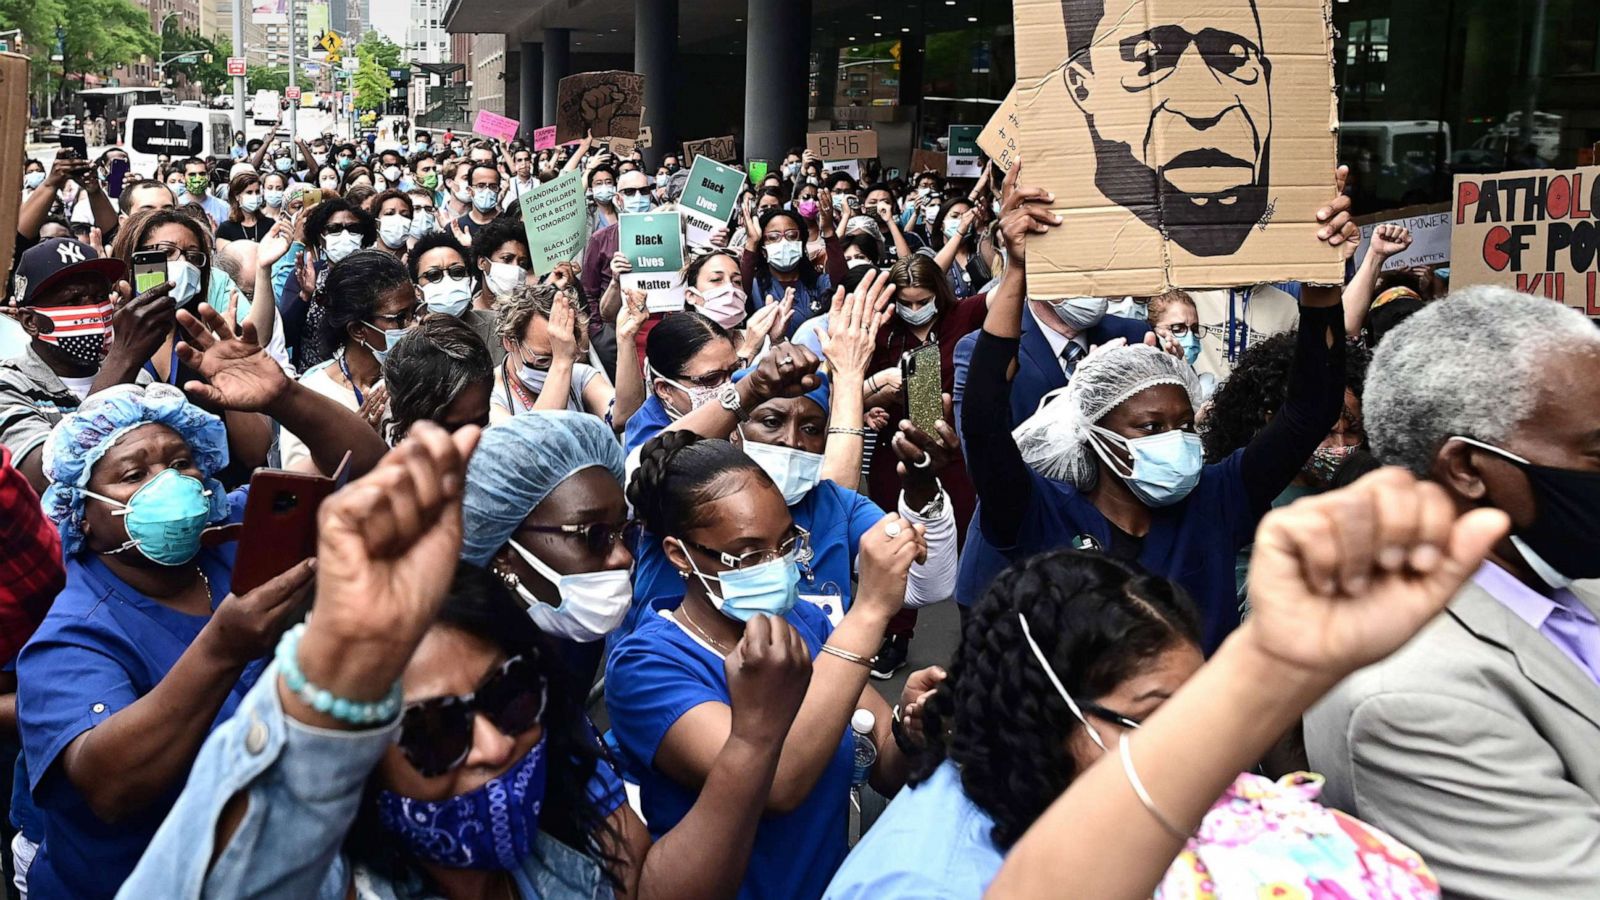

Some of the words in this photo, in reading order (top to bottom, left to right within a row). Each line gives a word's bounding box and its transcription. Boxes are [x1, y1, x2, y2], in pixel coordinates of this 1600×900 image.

[147, 137, 188, 147] AMBULETTE
[819, 135, 859, 157] 8:46
[1000, 149, 1014, 171] Rig
[525, 184, 559, 205] STANDING
[560, 176, 576, 189] WITH
[701, 177, 725, 194] Black
[530, 203, 544, 214] OUR
[546, 188, 577, 206] CHILDREN
[696, 195, 718, 212] Lives
[533, 213, 547, 223] FOR
[555, 199, 577, 214] BETTER
[686, 215, 714, 233] Matter
[1409, 214, 1449, 230] POWER
[543, 240, 565, 253] BLACK
[565, 231, 580, 244] LIVES
[635, 234, 663, 245] Black
[637, 256, 664, 267] Lives
[1410, 252, 1446, 265] MATTER
[637, 280, 671, 289] Matter
